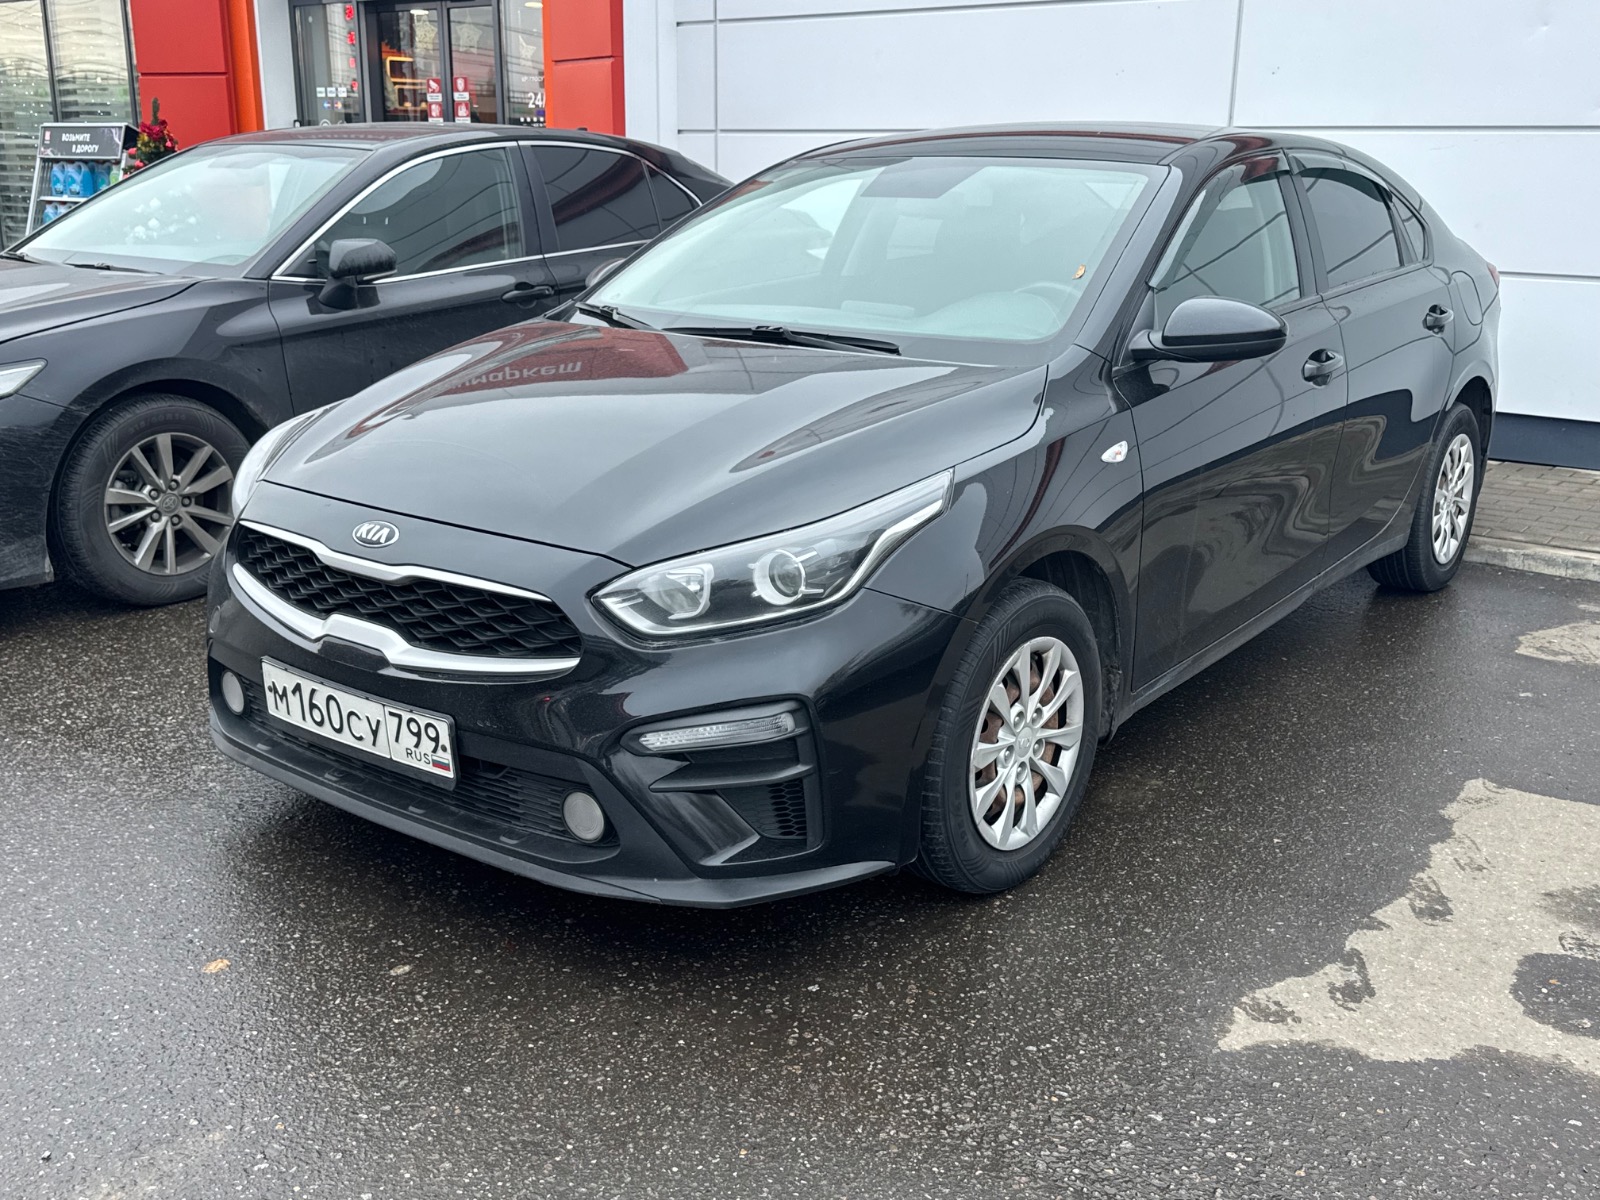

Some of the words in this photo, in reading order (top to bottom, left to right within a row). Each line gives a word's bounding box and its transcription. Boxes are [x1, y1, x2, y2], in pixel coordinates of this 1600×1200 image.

[62, 133, 90, 142] ВОЗЬМИТЕ
[76, 144, 99, 153] ДОРОГУ
[356, 523, 390, 543] KIA
[405, 747, 431, 765] RUS
